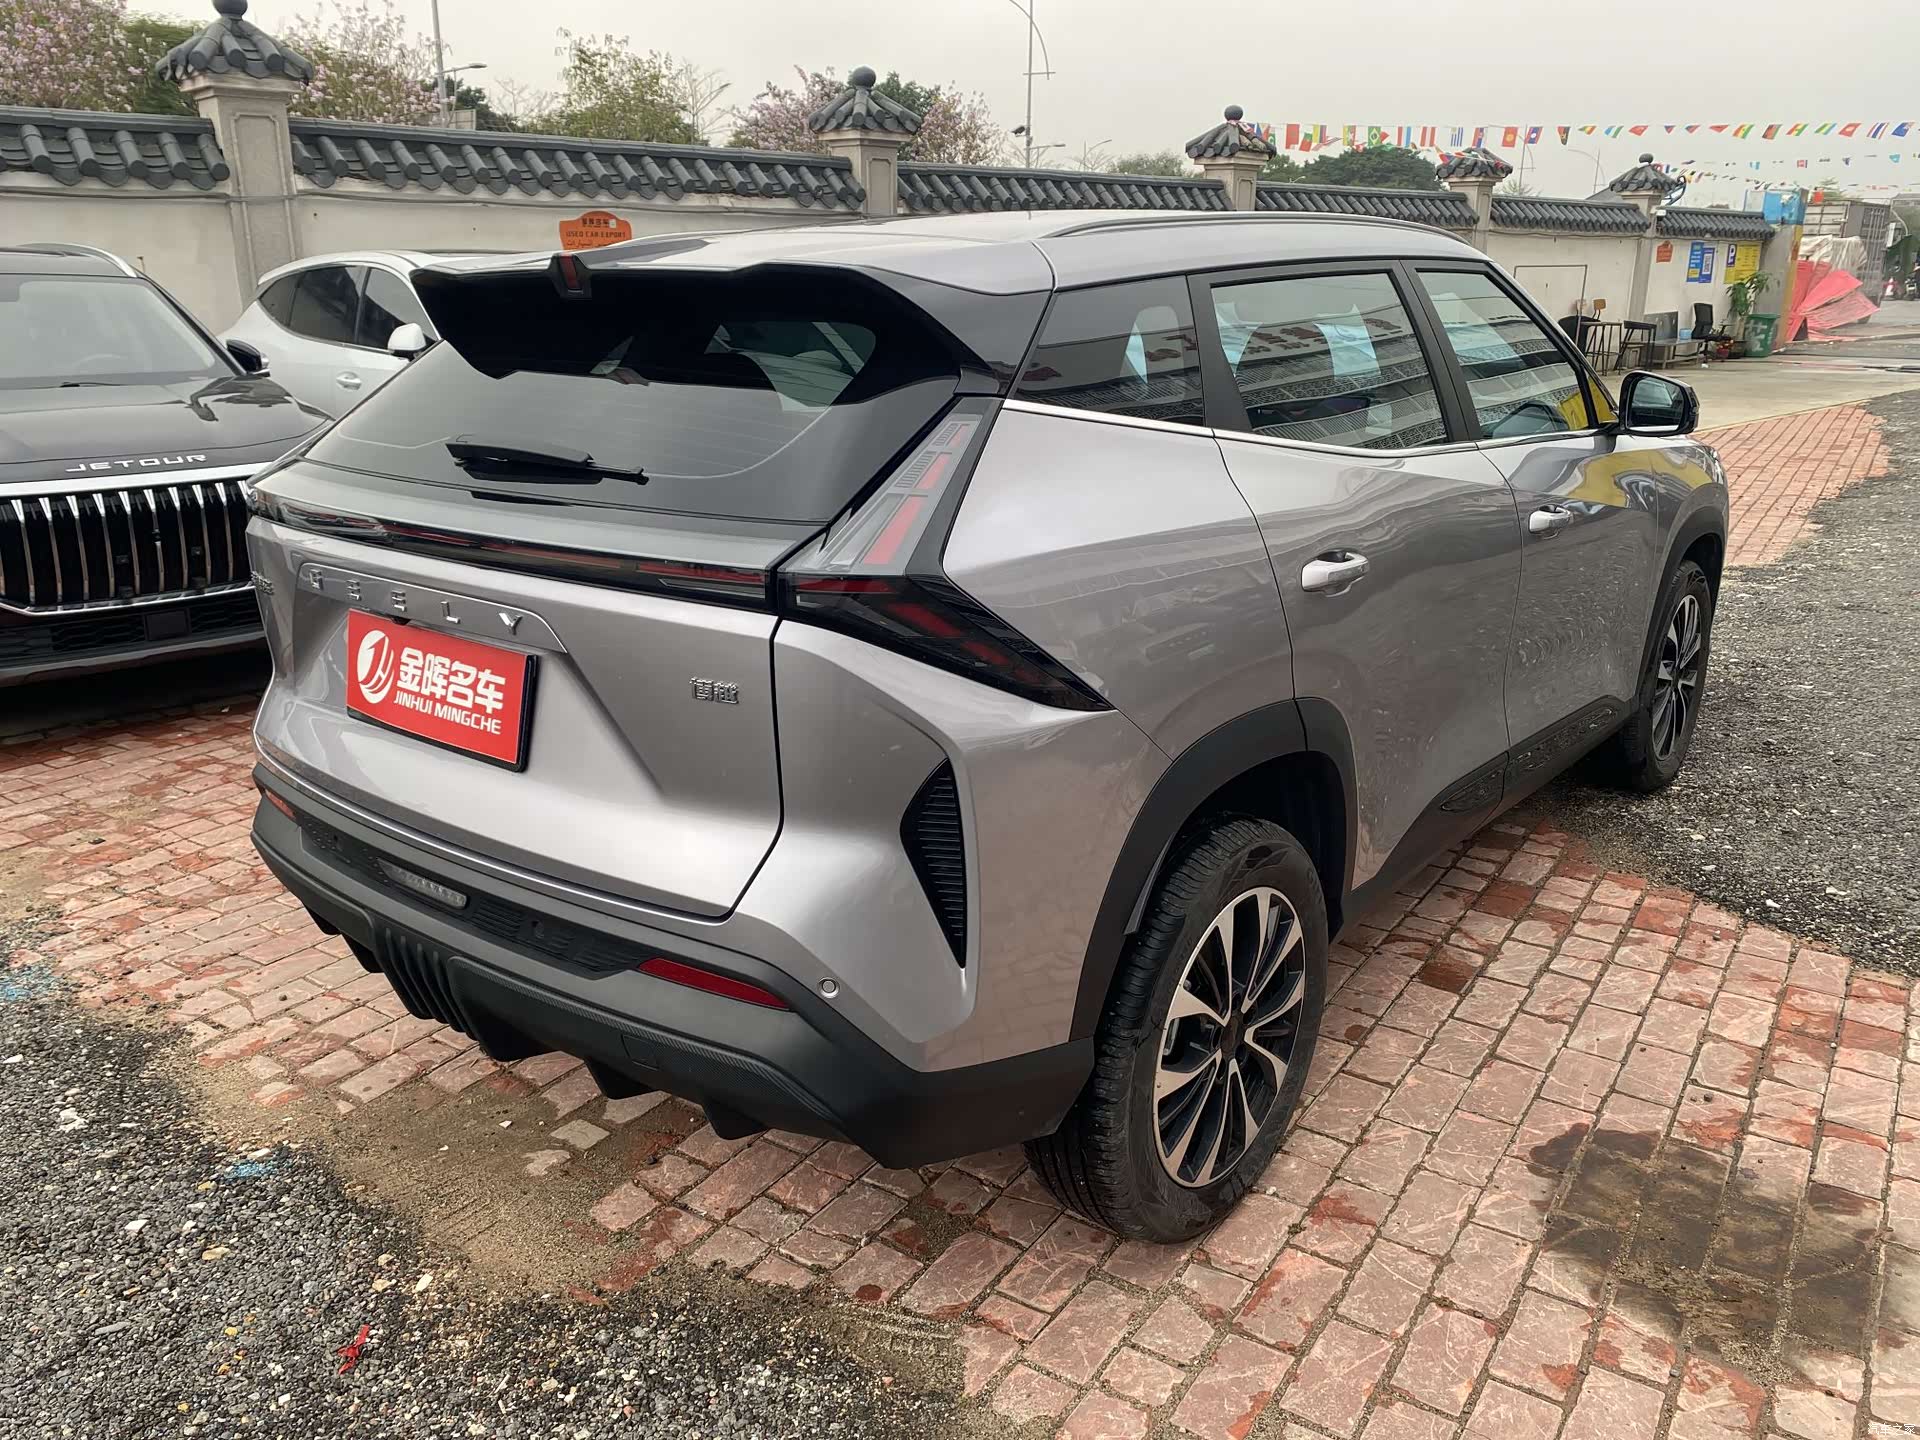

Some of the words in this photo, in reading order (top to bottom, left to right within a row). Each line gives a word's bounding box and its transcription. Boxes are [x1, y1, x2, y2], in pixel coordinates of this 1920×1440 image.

[65, 453, 208, 473] JETOUR
[309, 568, 523, 635] GEELY
[396, 646, 507, 714] 金晖名车
[393, 690, 433, 715] JINHUI
[434, 702, 503, 735] MINGCHE
